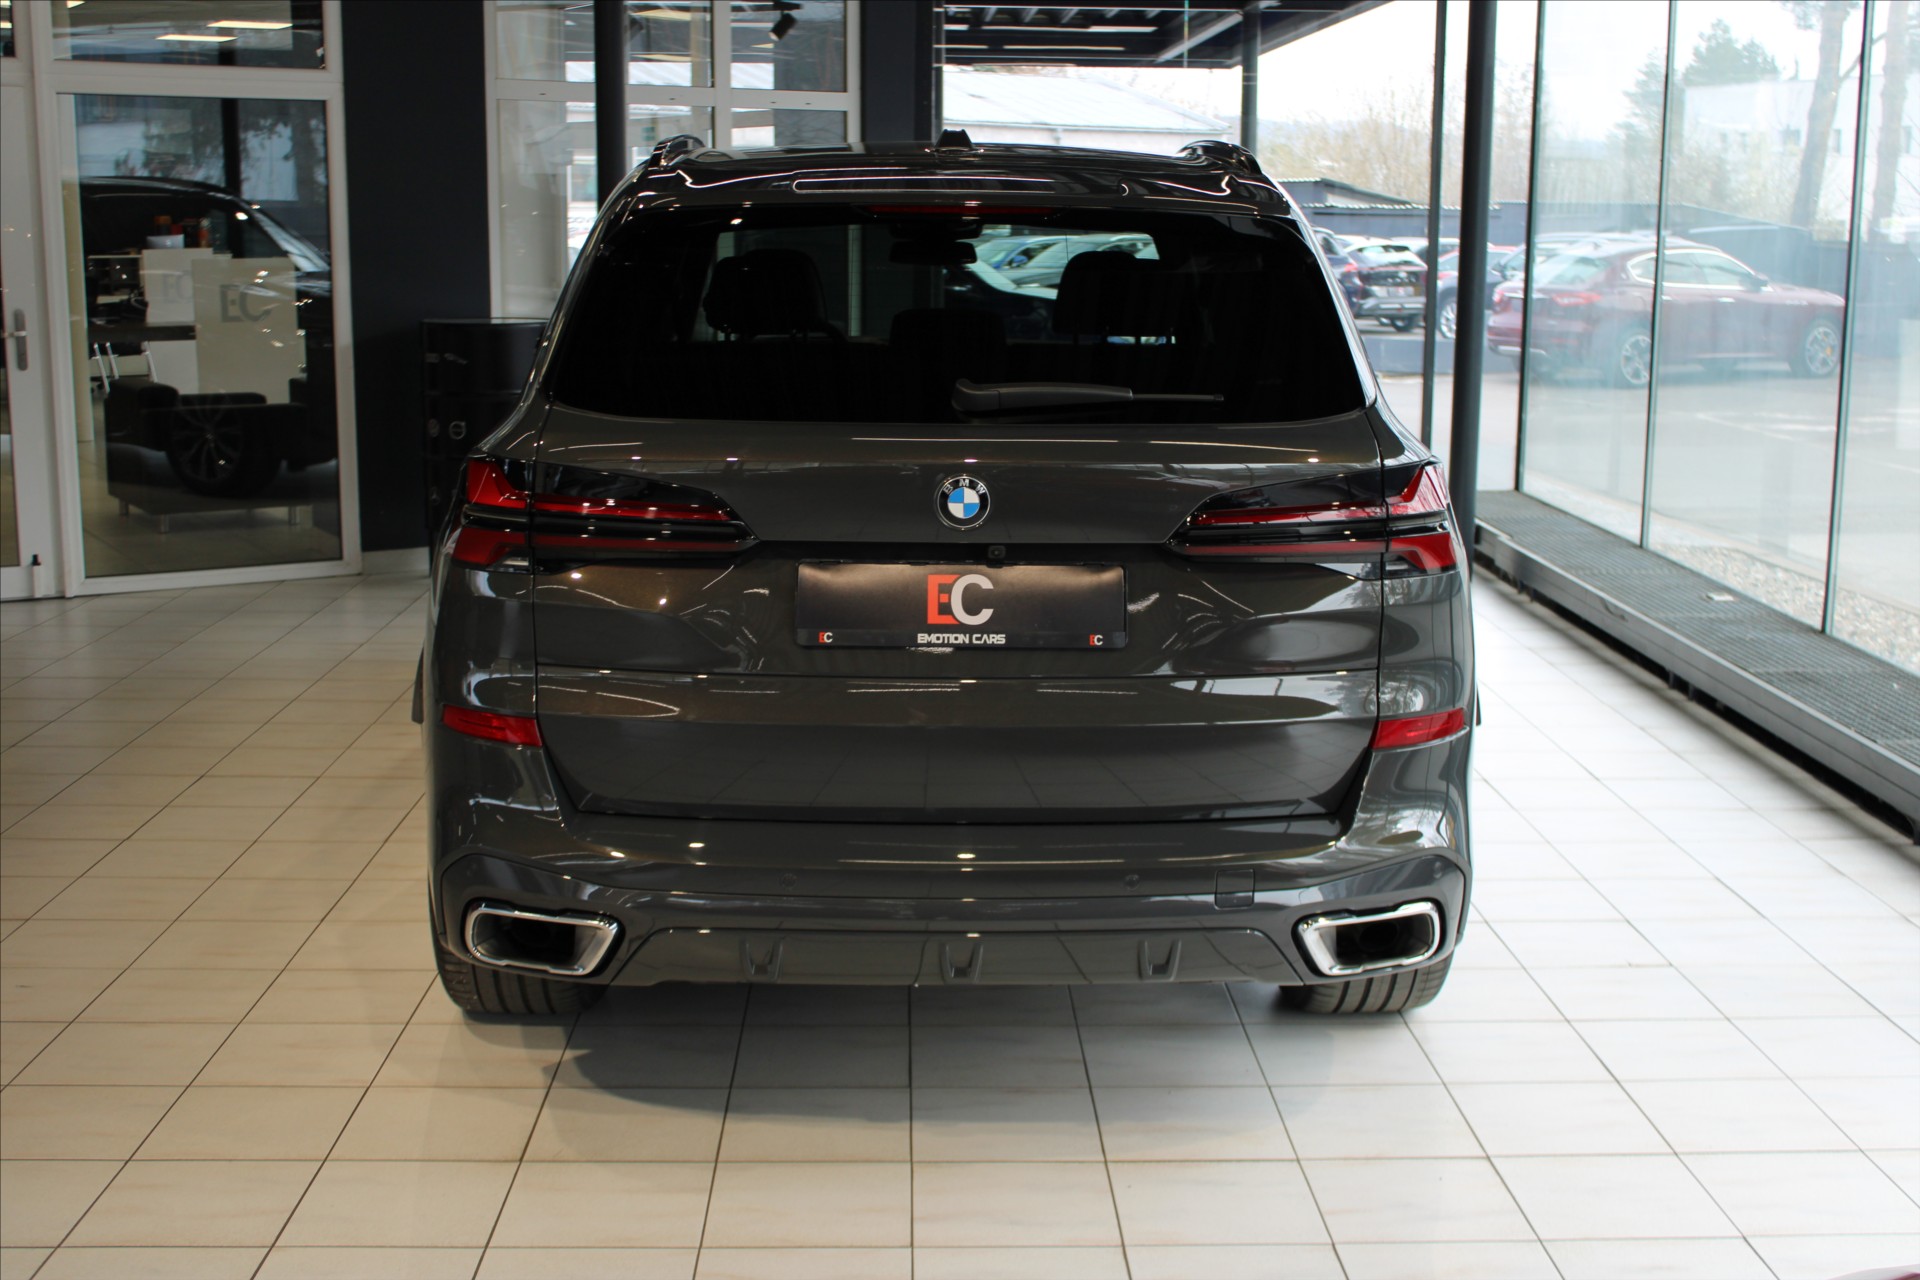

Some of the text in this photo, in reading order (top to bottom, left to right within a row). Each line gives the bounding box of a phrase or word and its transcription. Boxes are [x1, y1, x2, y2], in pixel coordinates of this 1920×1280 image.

[220, 284, 272, 323] EC
[943, 478, 986, 495] BMW
[927, 574, 994, 625] EC
[819, 632, 833, 643] EC
[917, 633, 1006, 644] EMOTION CARS
[1089, 634, 1103, 646] EC
